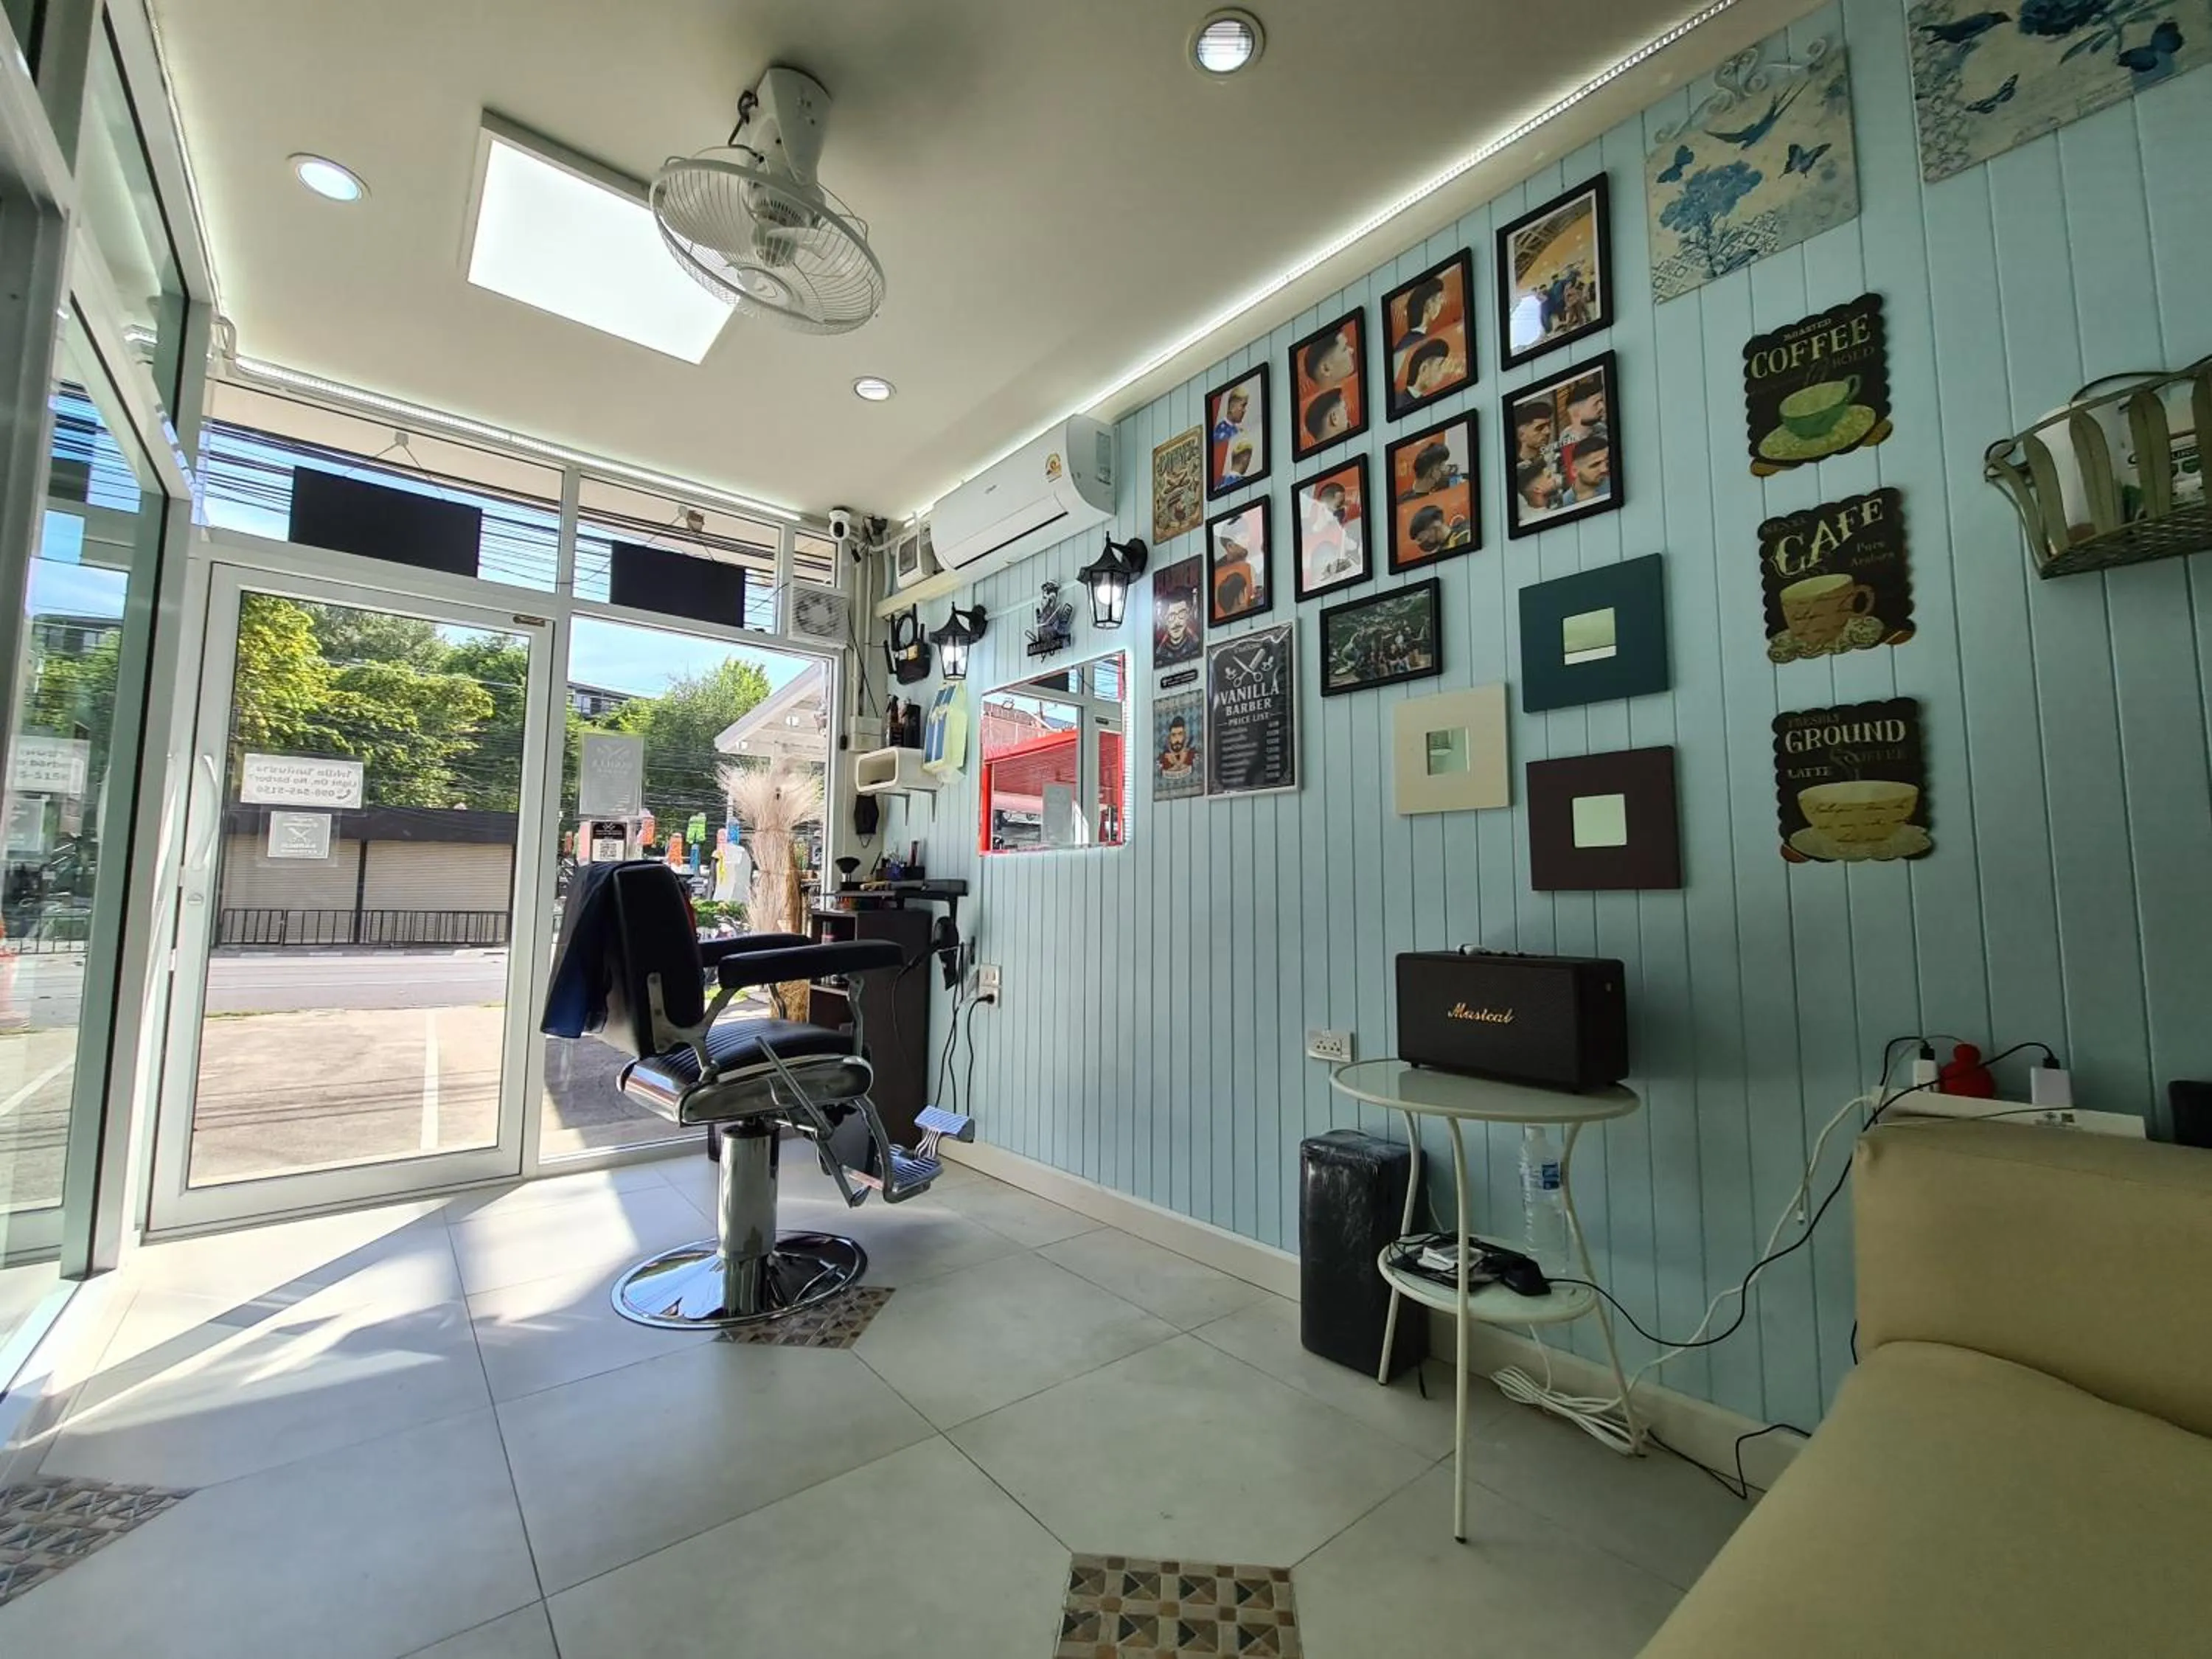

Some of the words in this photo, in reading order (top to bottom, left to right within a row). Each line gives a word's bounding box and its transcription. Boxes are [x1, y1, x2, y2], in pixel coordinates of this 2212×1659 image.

[1751, 313, 1871, 379] COFFEE
[1772, 498, 1883, 577] CAFE
[1220, 681, 1279, 705] VANILLA
[1225, 698, 1271, 717] BARBER
[1228, 715, 1251, 726] PRICE
[1253, 712, 1269, 722] LIST
[1785, 719, 1906, 754] GROUND
